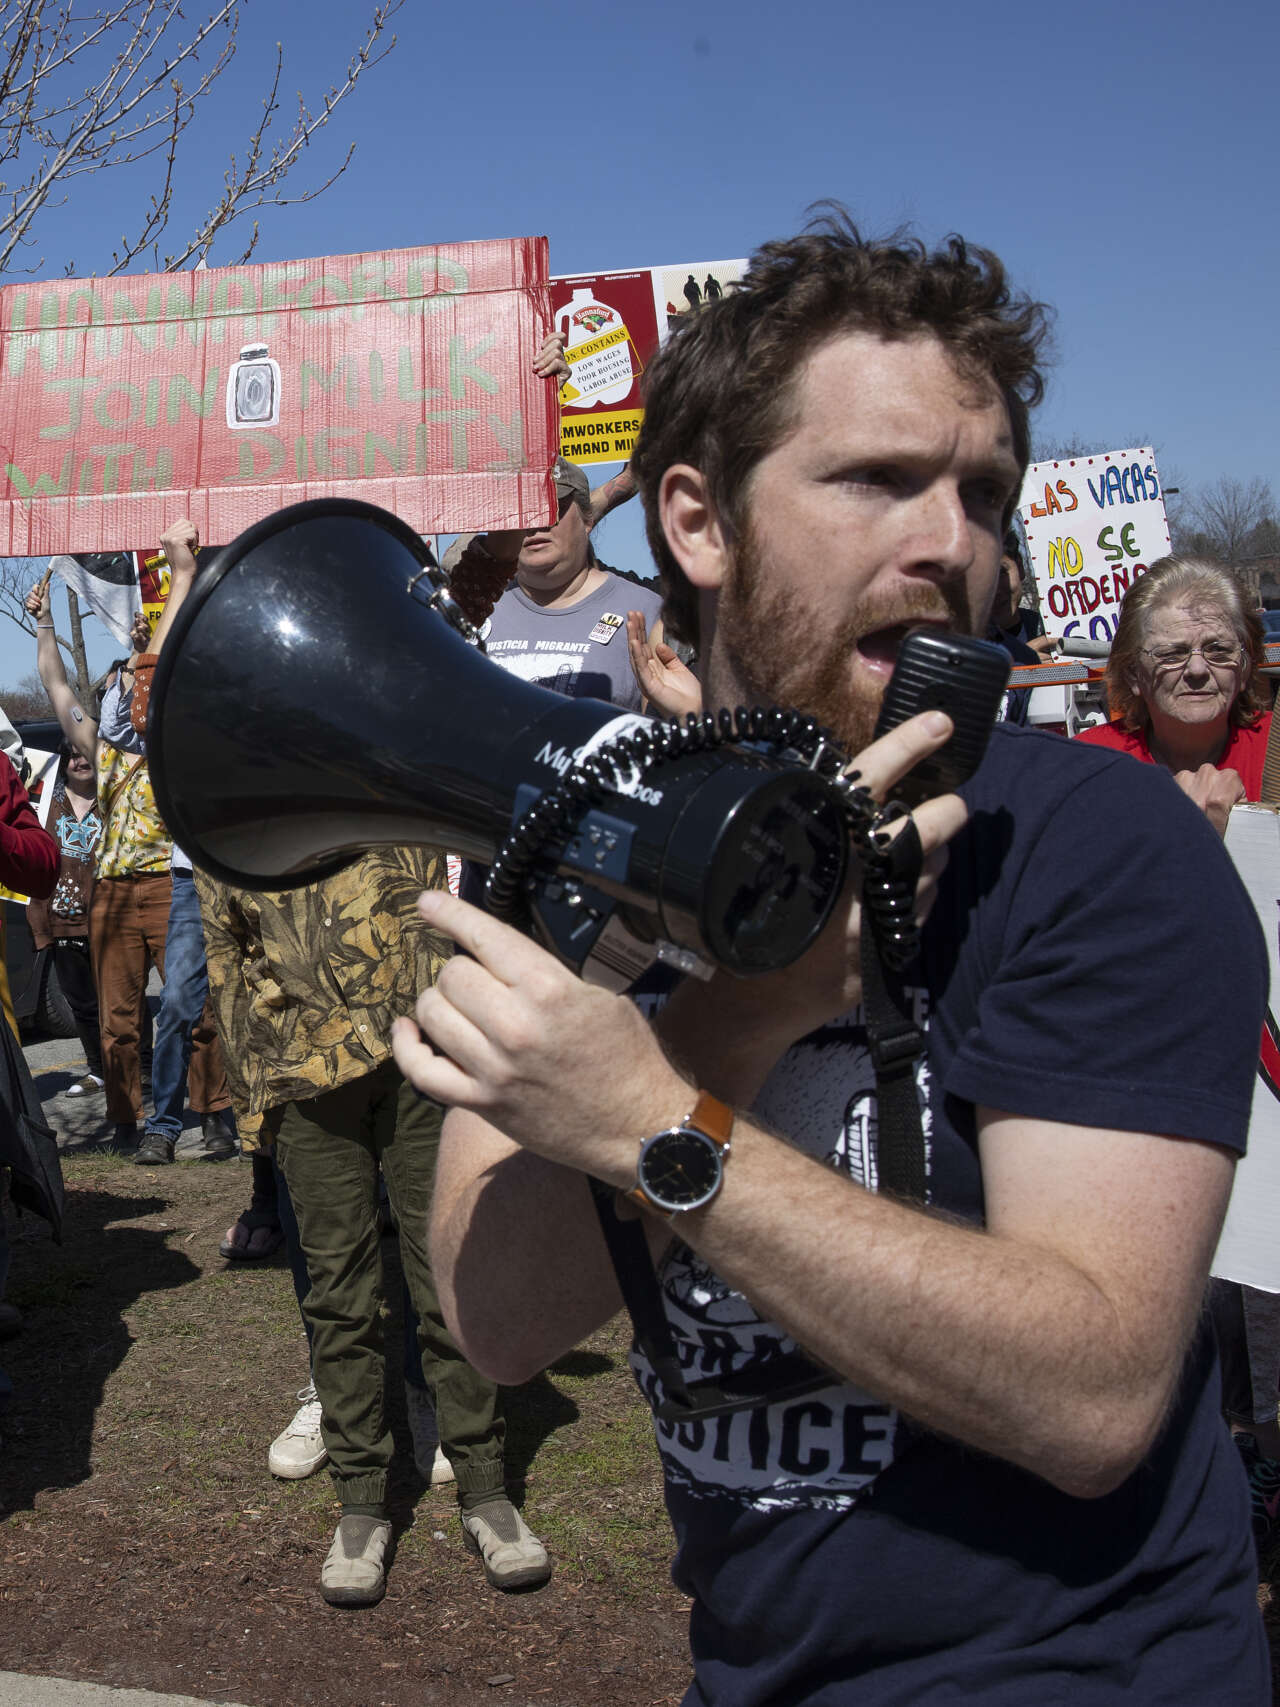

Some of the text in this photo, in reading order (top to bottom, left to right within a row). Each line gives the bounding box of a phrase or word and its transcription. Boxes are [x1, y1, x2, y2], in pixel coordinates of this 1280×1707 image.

[8, 255, 469, 376] HANNAFORD
[581, 329, 626, 356] CONTAINS
[577, 348, 622, 373] LOW WAGES
[577, 356, 630, 384] POOR HOUSING
[39, 332, 500, 441] JOIN MILK
[583, 366, 632, 393] LABOR ABUSE
[560, 420, 640, 439] MWORKERS
[4, 408, 528, 508] WITH DIGNITY
[1031, 462, 1160, 518] LAS VACAS
[1048, 522, 1141, 578] NO SE
[534, 640, 591, 653] MIGRANTE
